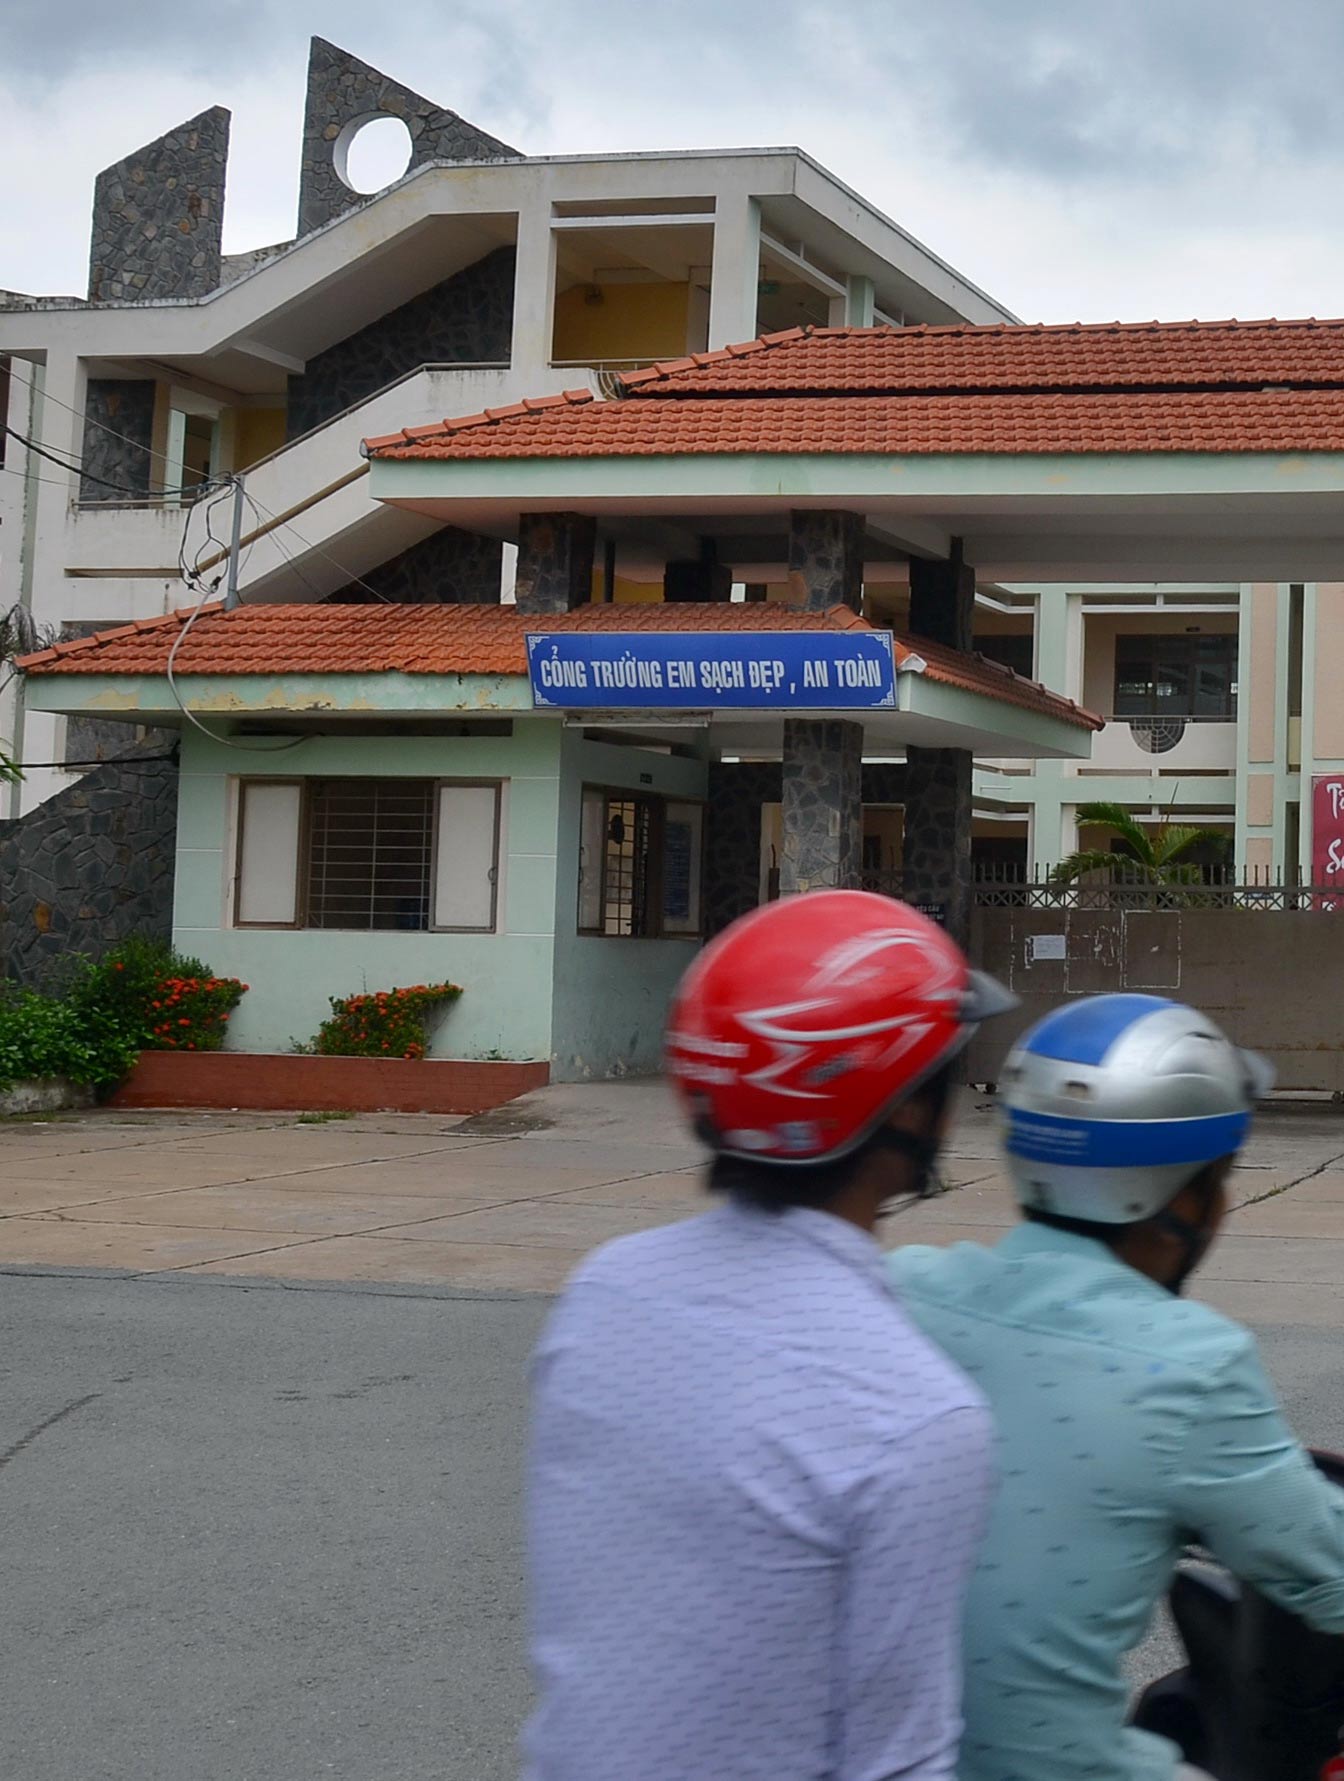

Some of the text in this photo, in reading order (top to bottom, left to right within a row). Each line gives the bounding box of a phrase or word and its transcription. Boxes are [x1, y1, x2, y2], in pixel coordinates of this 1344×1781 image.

[540, 645, 588, 688] CỔNG
[590, 651, 663, 688] TRƯỜNG
[666, 660, 697, 688] EM
[700, 660, 745, 694] SẠCH
[748, 660, 785, 694] ĐẸP
[803, 660, 829, 688] AN
[833, 653, 882, 688] TOÀN
